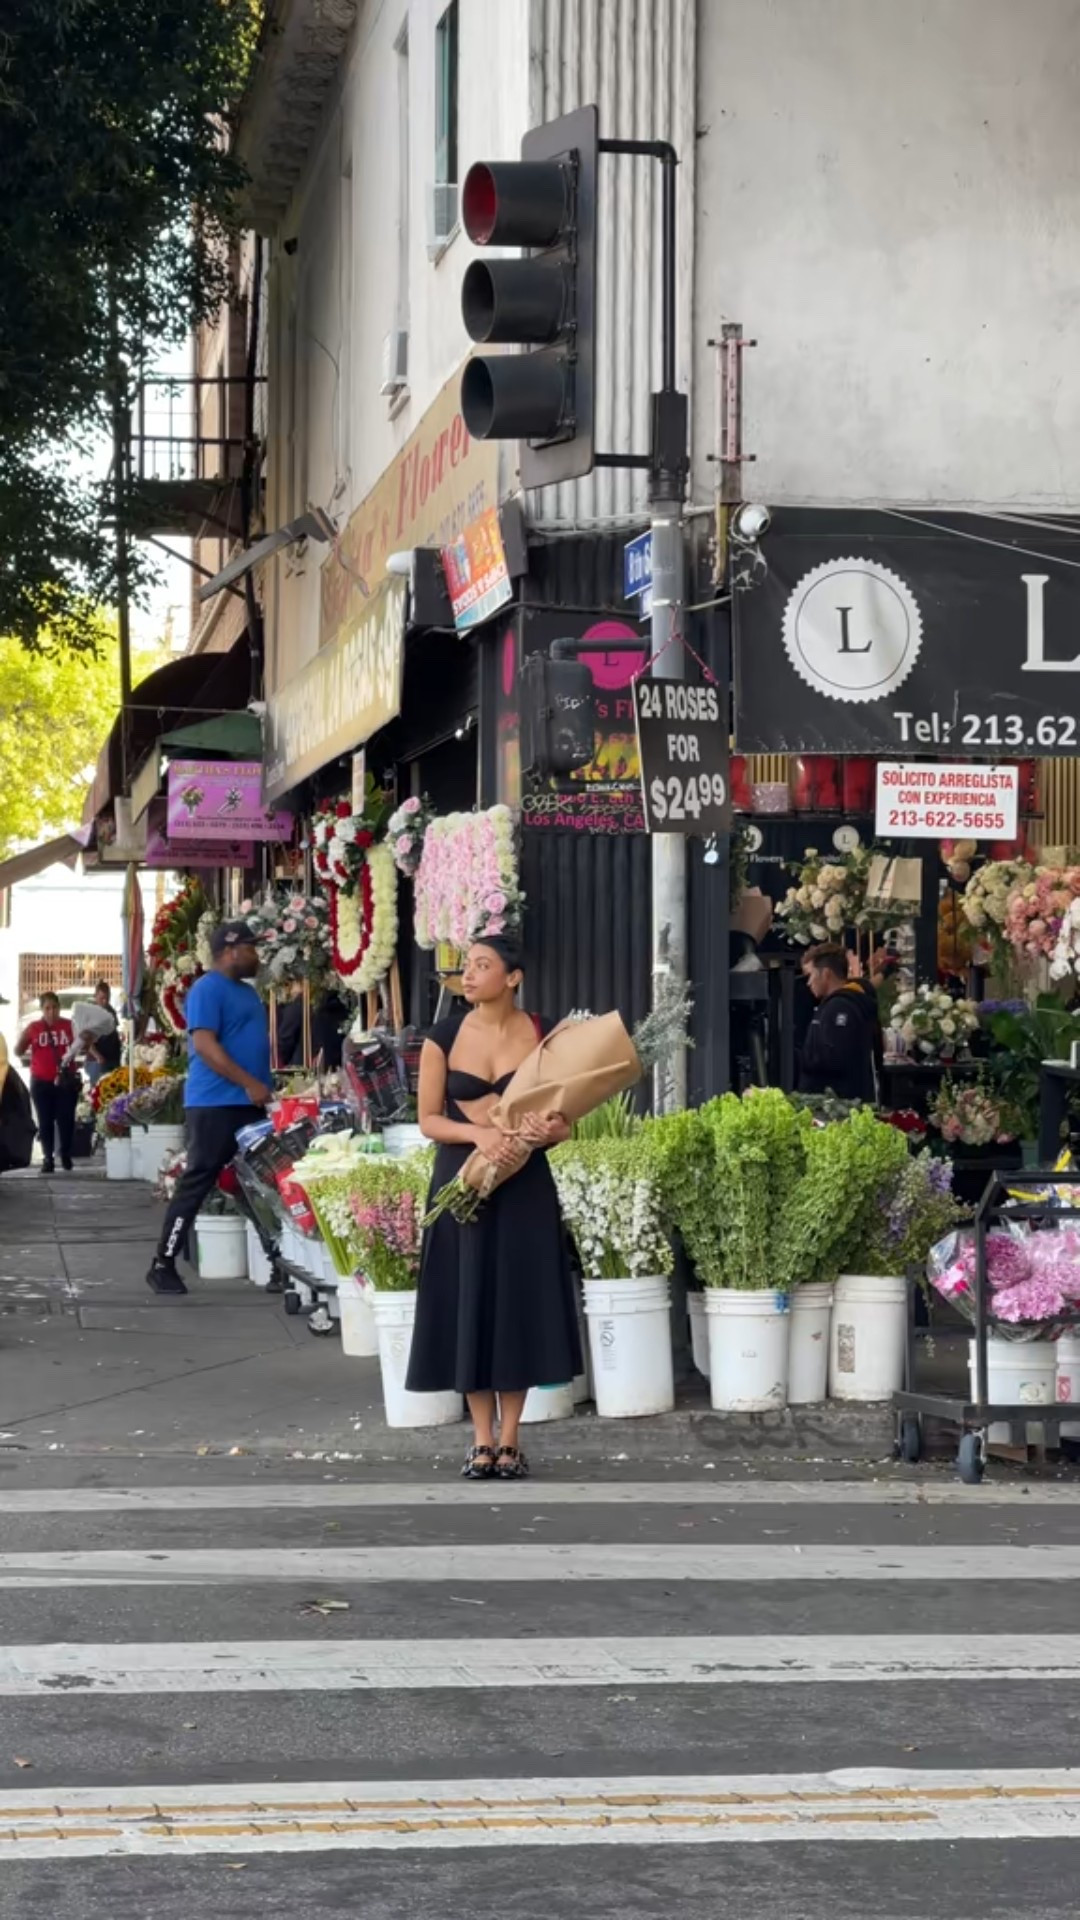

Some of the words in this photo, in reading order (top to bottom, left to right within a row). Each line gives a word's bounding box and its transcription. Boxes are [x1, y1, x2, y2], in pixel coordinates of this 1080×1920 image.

[836, 607, 872, 653] L
[639, 684, 662, 719] 24
[665, 685, 719, 721] ROSES
[893, 712, 951, 743] Tel:
[667, 733, 700, 762] FOR
[882, 770, 937, 787] SOLICITO
[939, 773, 1013, 789] ARREGLISTA
[898, 791, 921, 804] CON
[924, 792, 996, 806] EXPERIENCIA
[524, 813, 551, 826] Los
[888, 810, 1005, 829] 213-622-5655
